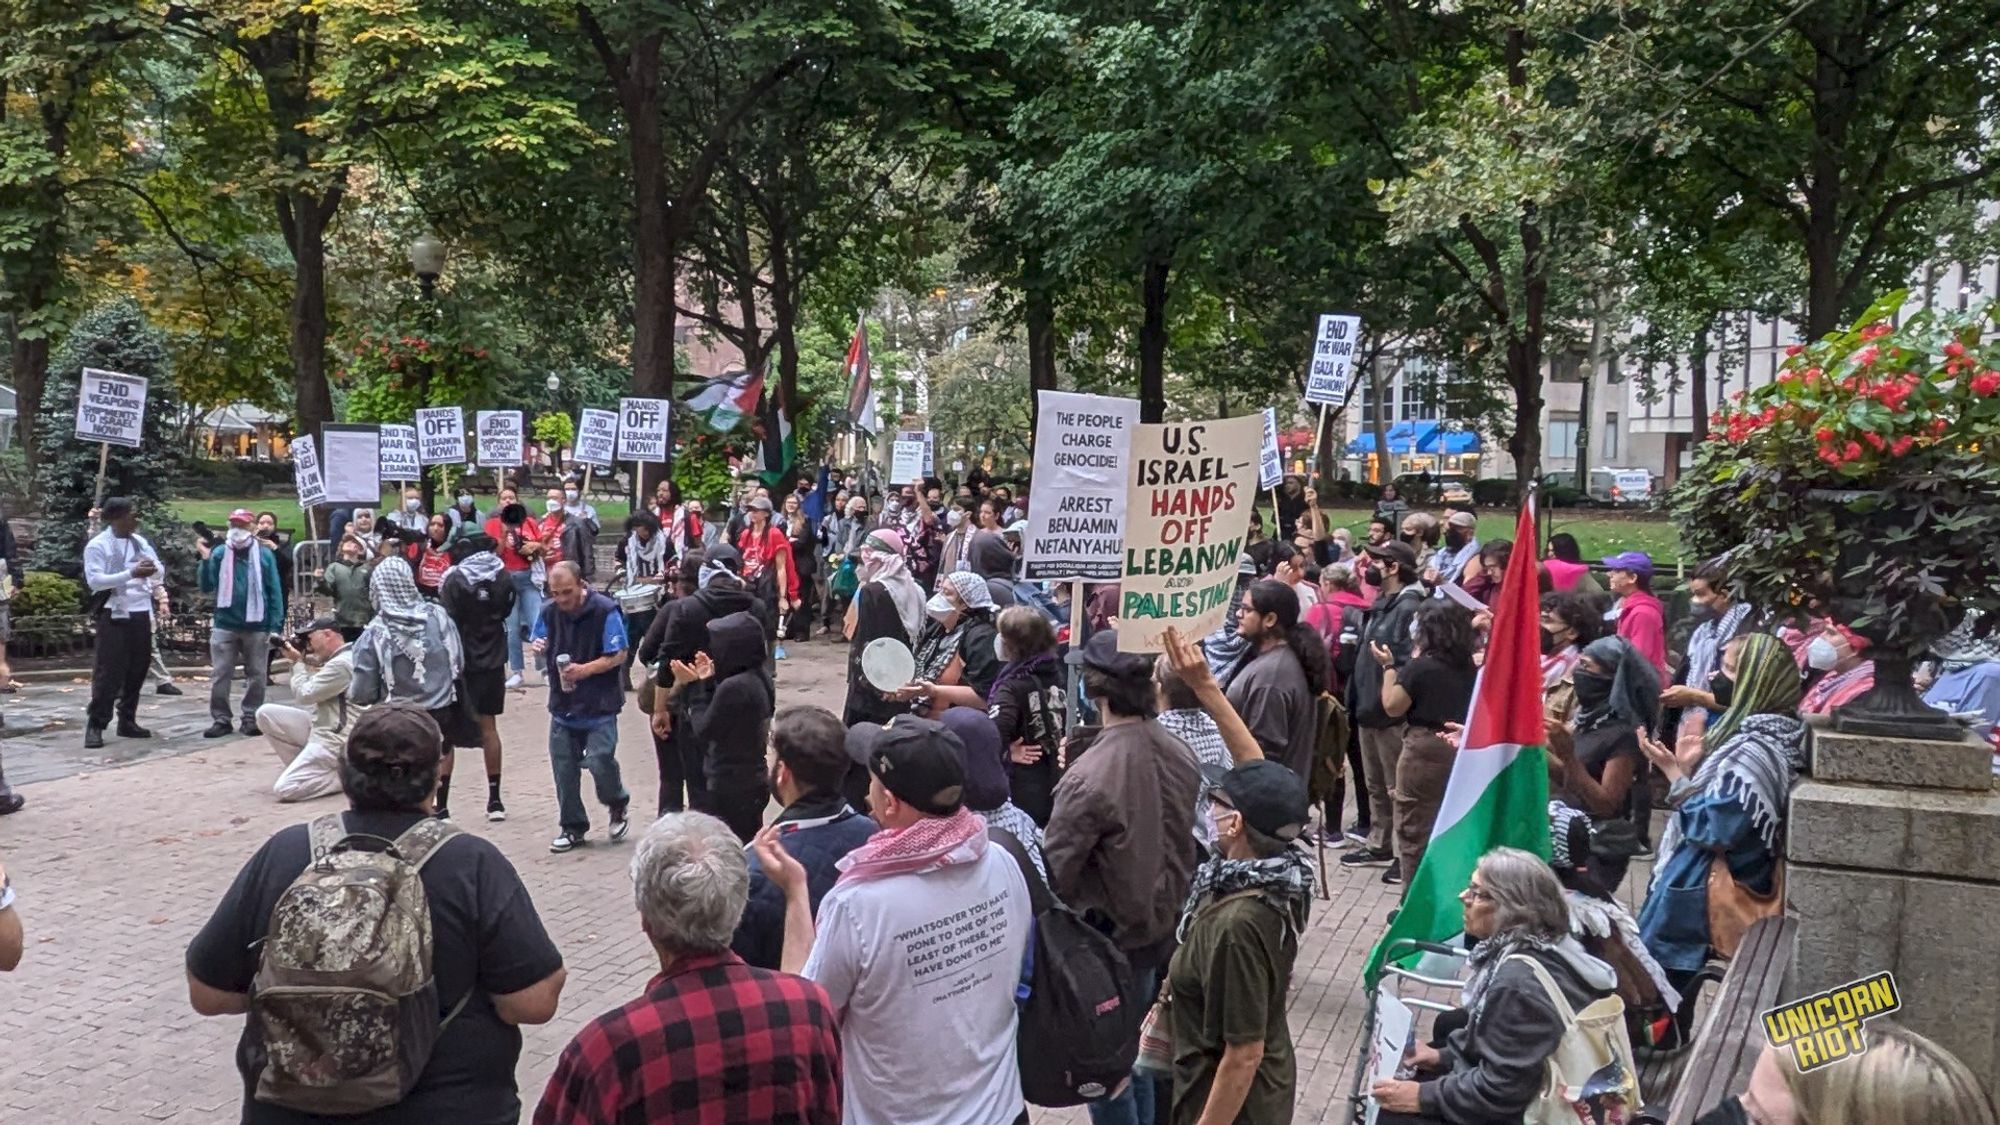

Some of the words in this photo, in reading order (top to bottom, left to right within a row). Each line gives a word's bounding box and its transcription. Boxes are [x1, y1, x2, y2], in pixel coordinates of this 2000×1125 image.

[1326, 320, 1348, 340] END
[1318, 340, 1330, 354] THE
[1332, 341, 1352, 356] WAR
[1314, 361, 1334, 376] GAZA
[1336, 362, 1344, 377] &
[99, 381, 130, 397] END
[89, 393, 140, 409] WEAPONS
[626, 400, 660, 411] HANDS
[83, 413, 96, 423] TO
[423, 409, 456, 418] HANDS
[626, 410, 660, 429] OFF
[1056, 411, 1074, 426] THE
[1077, 414, 1123, 429] PEOPLE
[424, 418, 456, 436] OFF
[489, 418, 511, 429] END
[589, 417, 607, 429] END
[381, 439, 403, 449] WAR
[421, 436, 461, 447] LEBANON
[621, 430, 663, 442] LEBANON
[907, 433, 925, 441] END
[1061, 433, 1112, 448] CHARGE
[1162, 426, 1208, 455] U.S.
[427, 445, 457, 458] NOW!
[626, 440, 657, 454] NOW!
[381, 453, 407, 463] GAZA
[1054, 452, 1118, 469] GENOCIDE!
[1058, 496, 1113, 513] ARREST
[1151, 482, 1238, 518] HANDS
[1048, 517, 1118, 534] BENJAMIN
[1160, 516, 1213, 545] OFF
[1126, 536, 1243, 576] LEBANON
[1164, 577, 1194, 588] AND
[1122, 576, 1234, 619] PALESTINE
[968, 901, 988, 916] YOU
[989, 889, 1009, 907] HAVE
[906, 936, 936, 954] DONE
[938, 931, 952, 942] TO
[954, 921, 974, 936] ONE
[975, 915, 988, 927] OF
[990, 907, 1005, 920] THE
[907, 949, 940, 967] LEAST
[942, 943, 956, 955] OF
[959, 930, 989, 948] THESE,
[990, 919, 1008, 934] YOU
[914, 961, 943, 978] HAVE
[945, 949, 973, 967] DONE
[974, 943, 988, 954] TO
